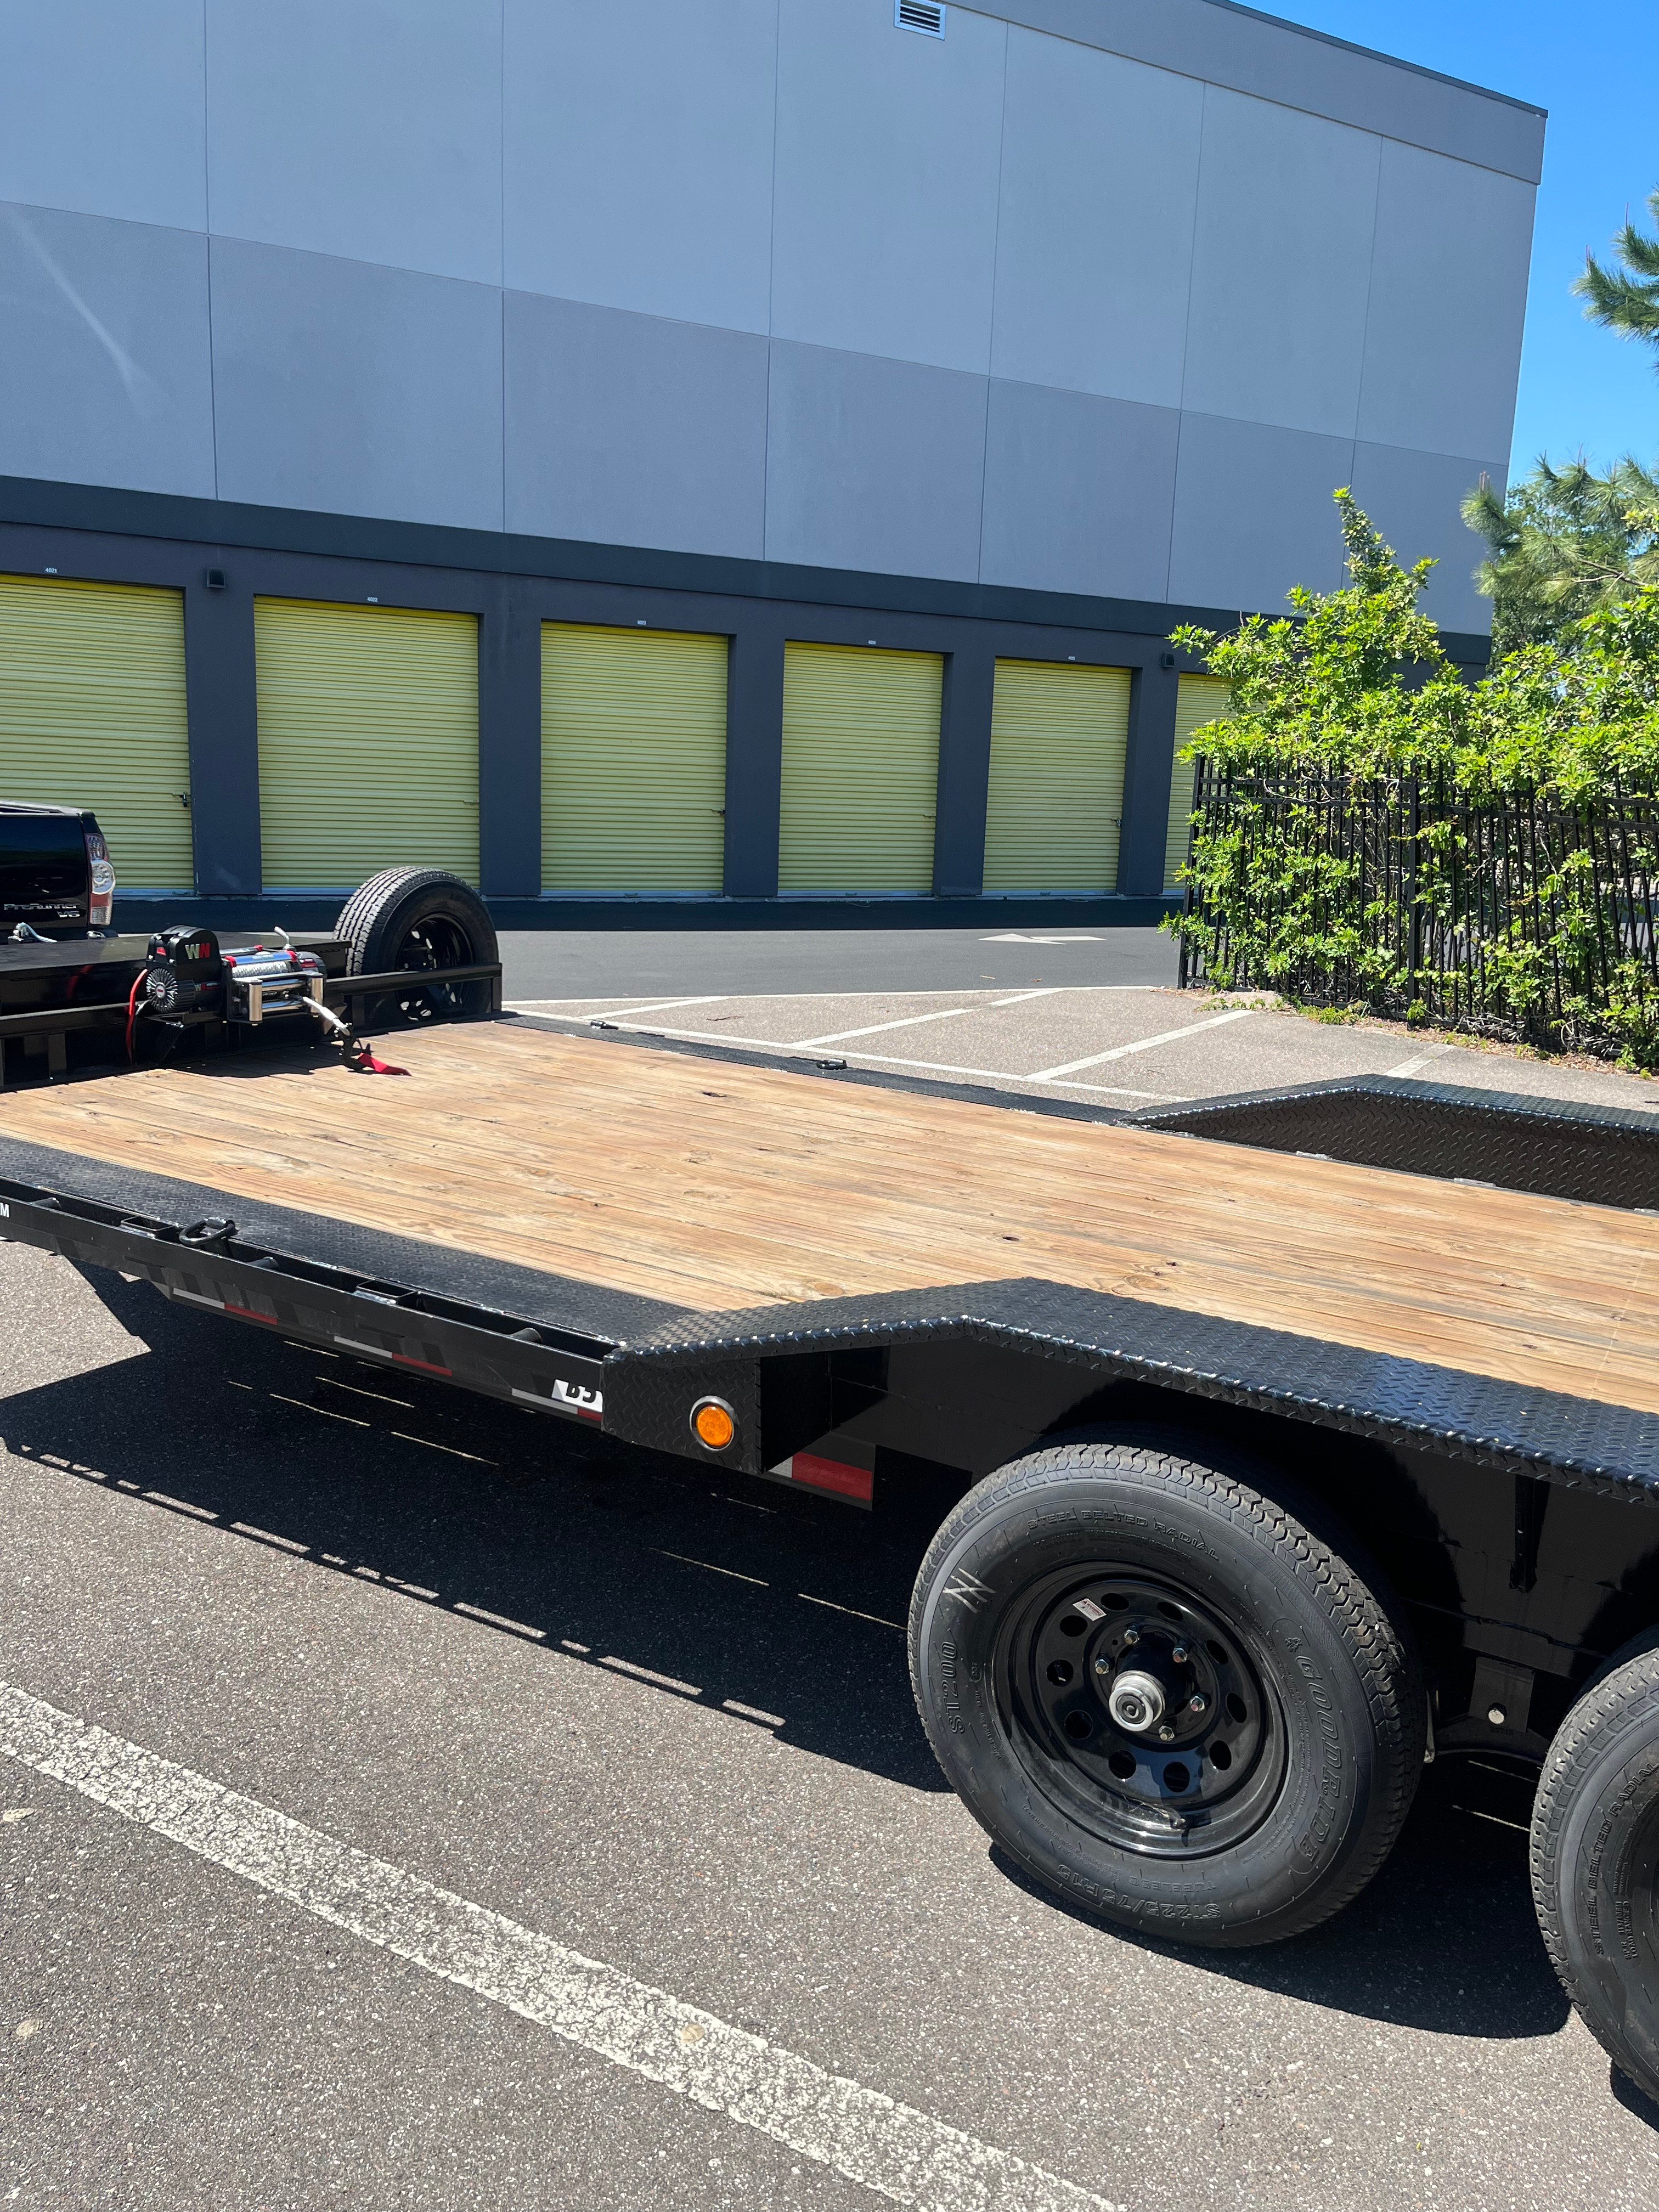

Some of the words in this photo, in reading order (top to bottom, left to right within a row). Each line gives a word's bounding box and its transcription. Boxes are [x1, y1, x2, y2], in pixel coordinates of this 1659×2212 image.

[1027, 1510, 1077, 1530] STEEL
[1081, 1510, 1148, 1527] BELTED
[1154, 1521, 1219, 1561] RADIAL
[940, 1641, 966, 1734] ST200
[1295, 1656, 1342, 1862] GOODRIDE
[1608, 1761, 1659, 1817] RADIAL
[1588, 1819, 1612, 1889] BELTED
[1056, 1864, 1221, 1920] ST225/75R15
[1129, 1875, 1217, 1893] TUBELESS
[1588, 1895, 1604, 1955] STEEL
